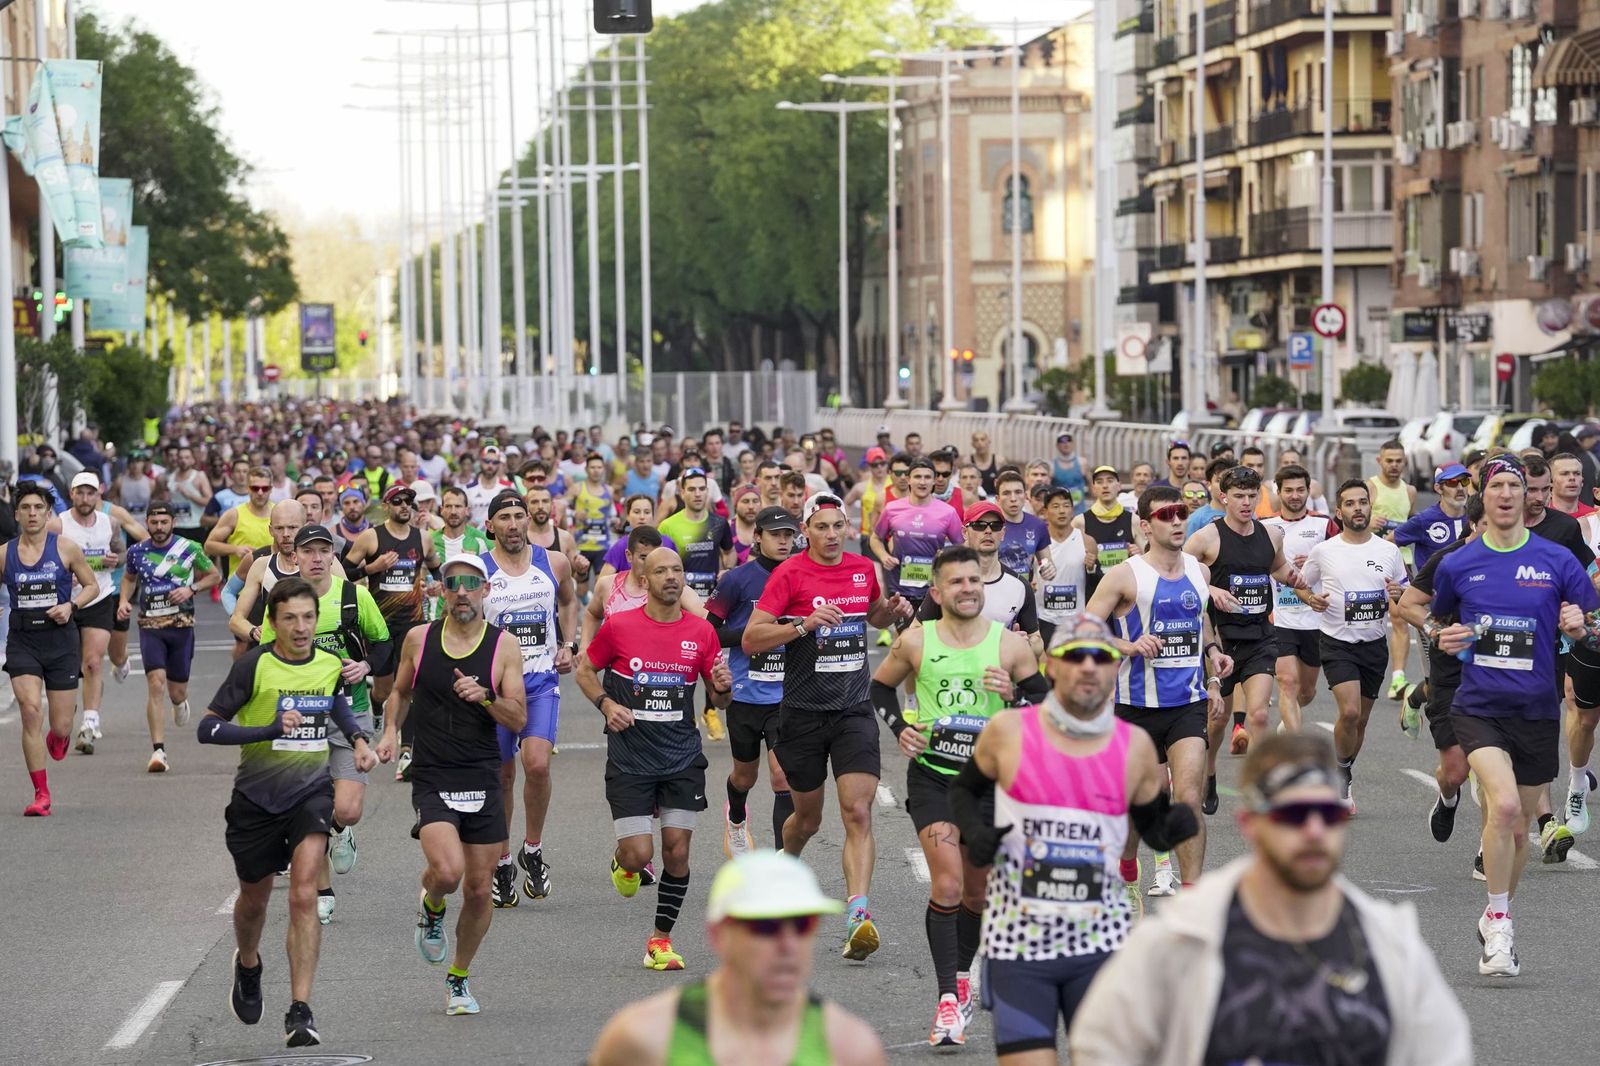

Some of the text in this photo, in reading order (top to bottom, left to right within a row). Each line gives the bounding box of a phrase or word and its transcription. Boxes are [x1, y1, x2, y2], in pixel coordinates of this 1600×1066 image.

[1292, 336, 1308, 358] P
[906, 573, 929, 581] HERON
[1515, 565, 1552, 581] Metz
[385, 576, 410, 584] HAMZA
[1244, 576, 1266, 584] ZURICH
[151, 584, 172, 593] ZURICH
[30, 592, 58, 601] THOMPSON
[1359, 591, 1383, 599] ZURICH
[827, 595, 869, 606] outsystems
[1046, 601, 1075, 610] ALBERTO
[1238, 596, 1262, 605] STUBY
[1352, 610, 1380, 620] JOAN 2
[1166, 621, 1193, 630] ZURICH
[1495, 618, 1529, 628] ZURICH
[833, 625, 859, 634] ZURICH
[518, 635, 537, 645] ABIO
[1494, 633, 1514, 642] 5148
[835, 640, 850, 648] 4104
[1160, 645, 1191, 657] JULIEN
[1495, 645, 1511, 657] JB
[816, 653, 842, 663] JOHNNY
[644, 660, 693, 672] outsystems
[761, 662, 785, 671] JUAN
[652, 675, 681, 683] ZURICH
[651, 689, 668, 697] 4322
[297, 698, 328, 708] ZURICH
[645, 699, 672, 710] PONA
[953, 732, 973, 743] 4523
[934, 740, 976, 757] JOAQU
[450, 790, 486, 801] MARTINS
[1023, 818, 1102, 840] ENTRENA
[928, 823, 957, 848] 42
[1051, 846, 1098, 858] ZURICH
[1036, 880, 1089, 901] PABLO
